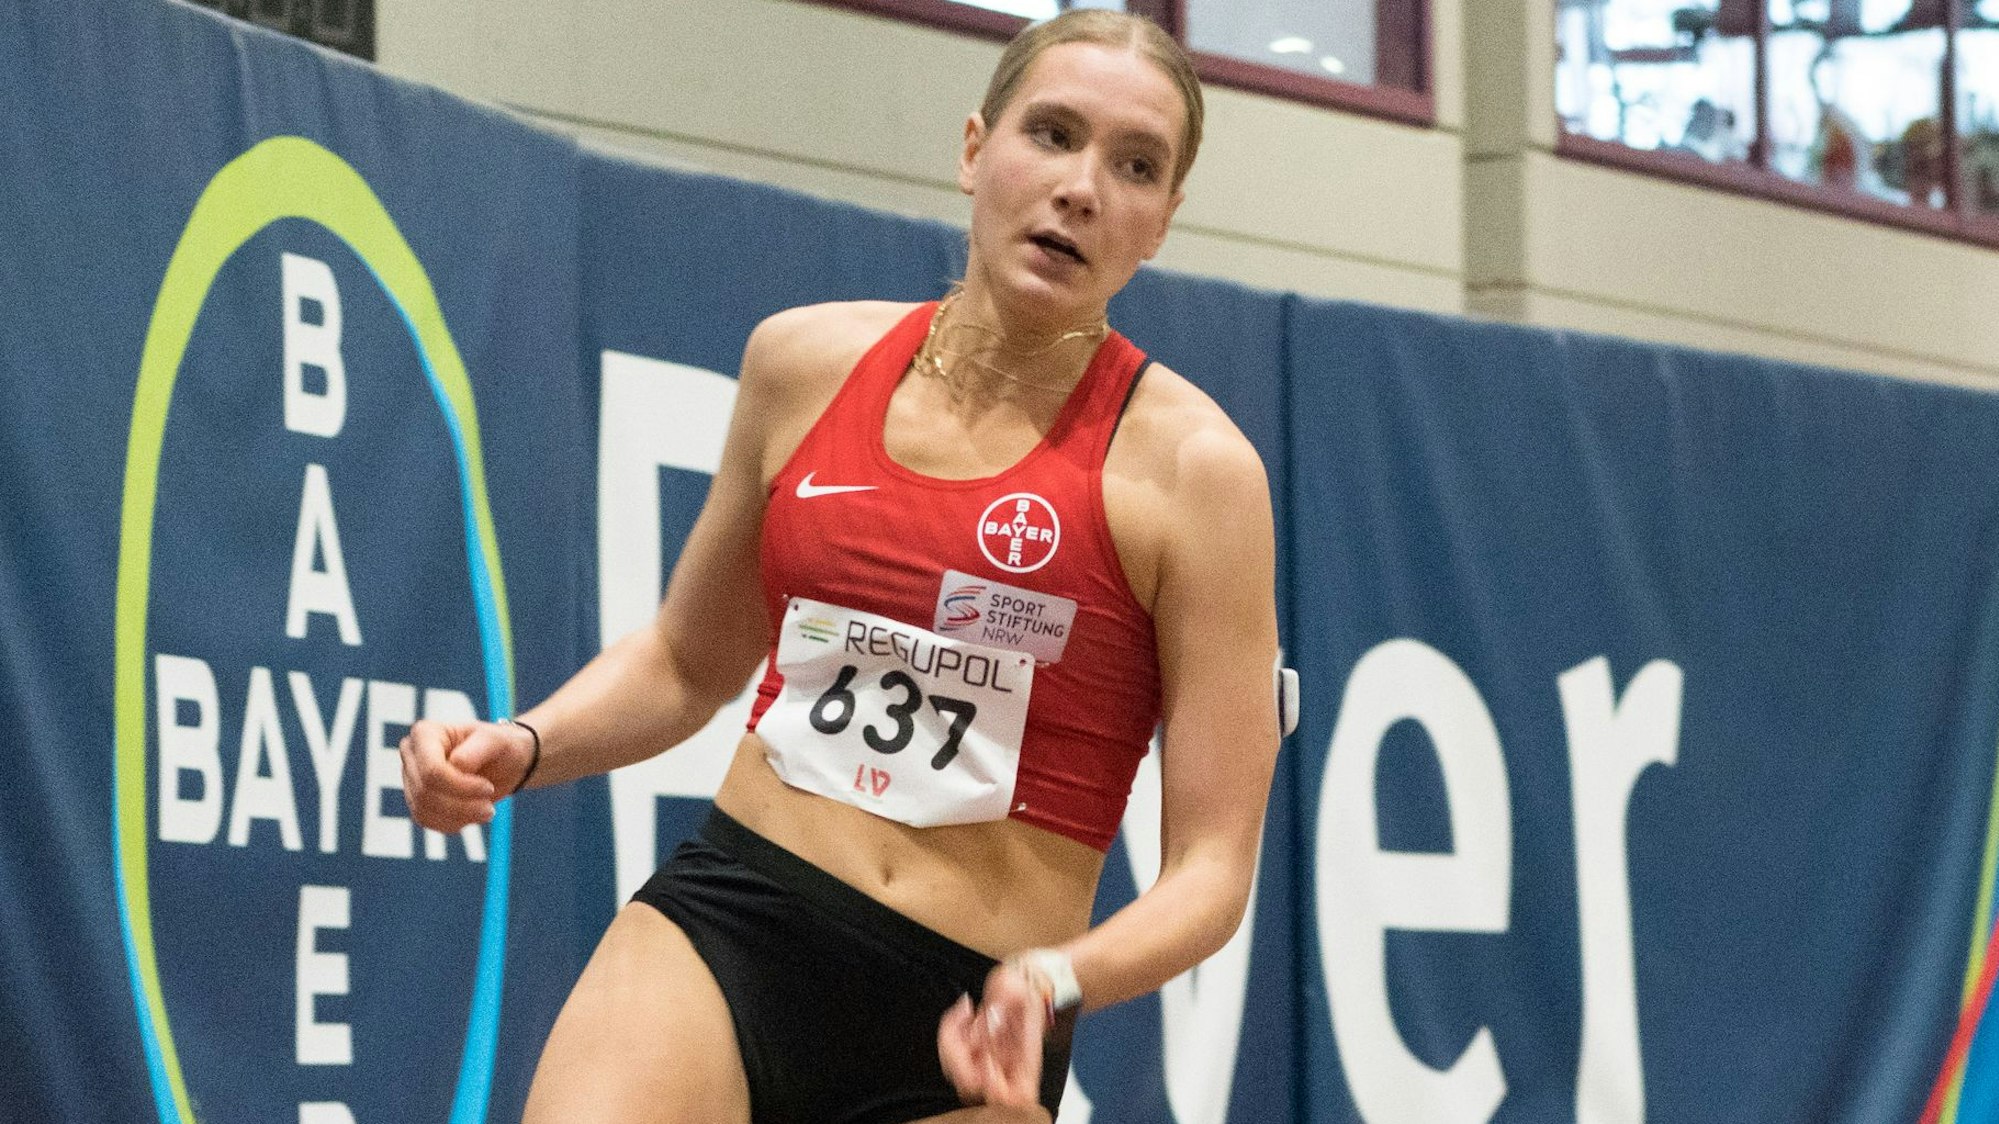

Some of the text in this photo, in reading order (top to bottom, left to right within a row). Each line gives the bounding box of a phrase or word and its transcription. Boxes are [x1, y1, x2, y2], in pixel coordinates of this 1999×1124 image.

[984, 522, 1053, 544] BAYER
[1007, 499, 1031, 566] BAYER
[986, 610, 1065, 638] STIFTUNG
[990, 594, 1046, 617] SPORT
[844, 620, 1013, 693] REGUPOL
[982, 627, 1024, 645] NRW
[281, 252, 363, 1124] BAYE
[809, 665, 977, 771] 637
